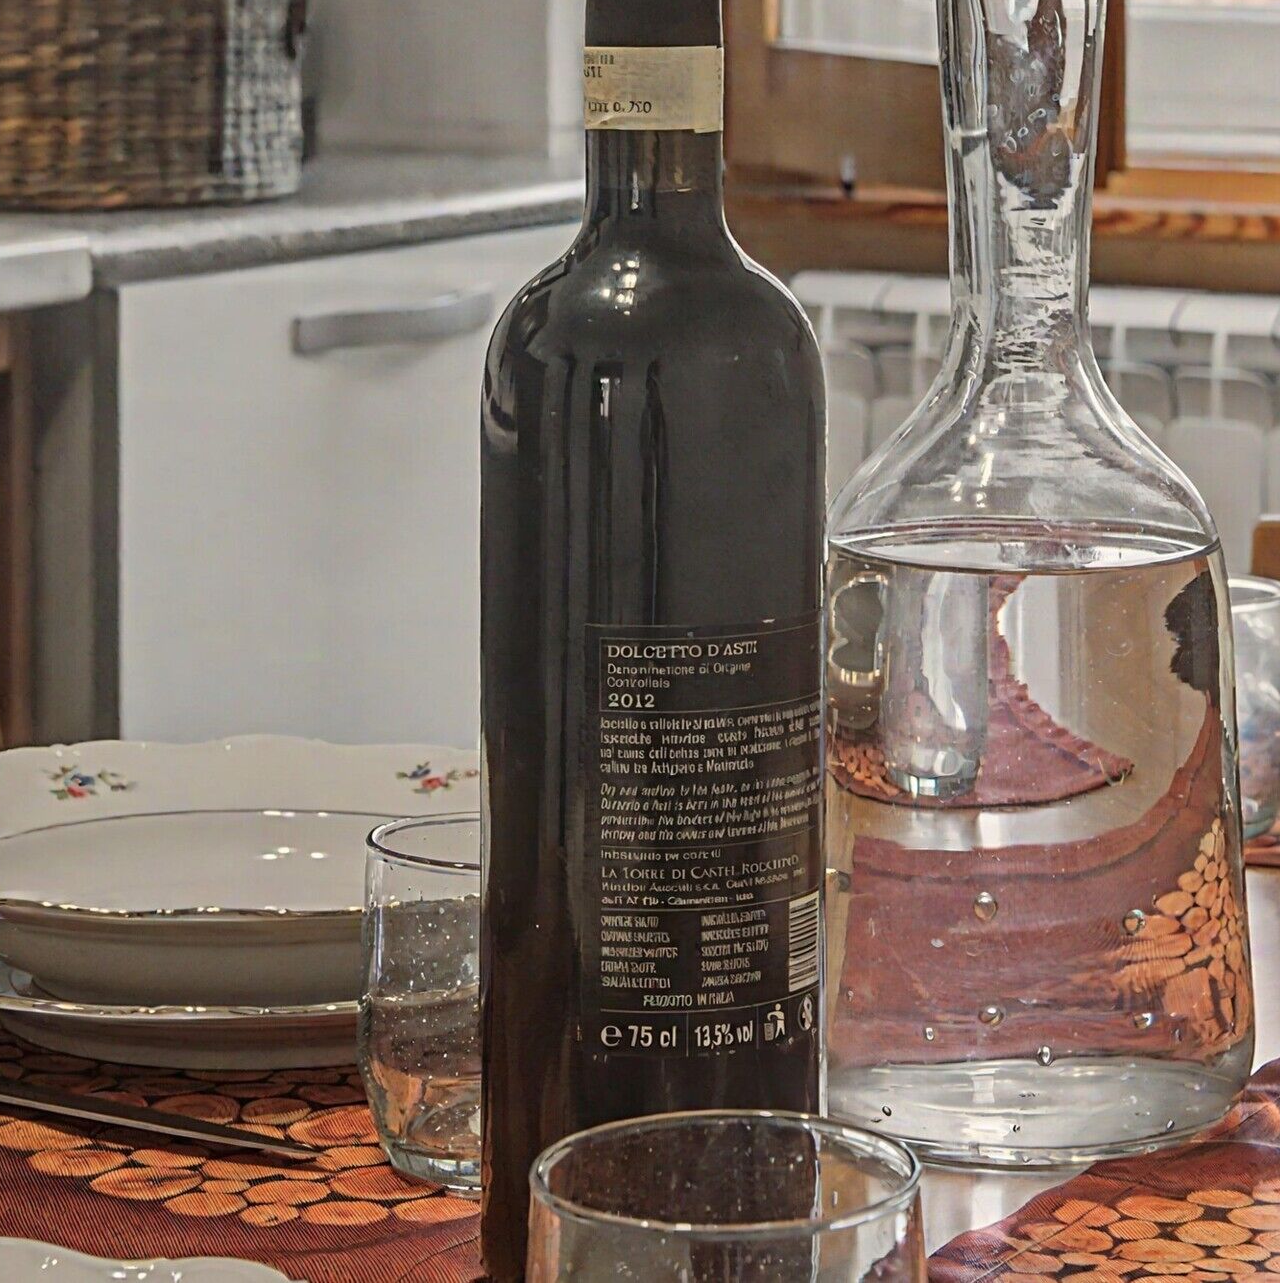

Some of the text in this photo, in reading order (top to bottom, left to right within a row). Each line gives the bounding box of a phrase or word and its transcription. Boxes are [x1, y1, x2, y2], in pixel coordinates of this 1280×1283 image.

[607, 644, 703, 659] DOLCETTO
[608, 692, 656, 708] 2012
[601, 866, 618, 879] LA
[672, 868, 686, 880] DI
[628, 1025, 654, 1048] 75
[659, 1025, 677, 1048] cl
[694, 1023, 734, 1050] 13,5%
[736, 1020, 754, 1044] vol
